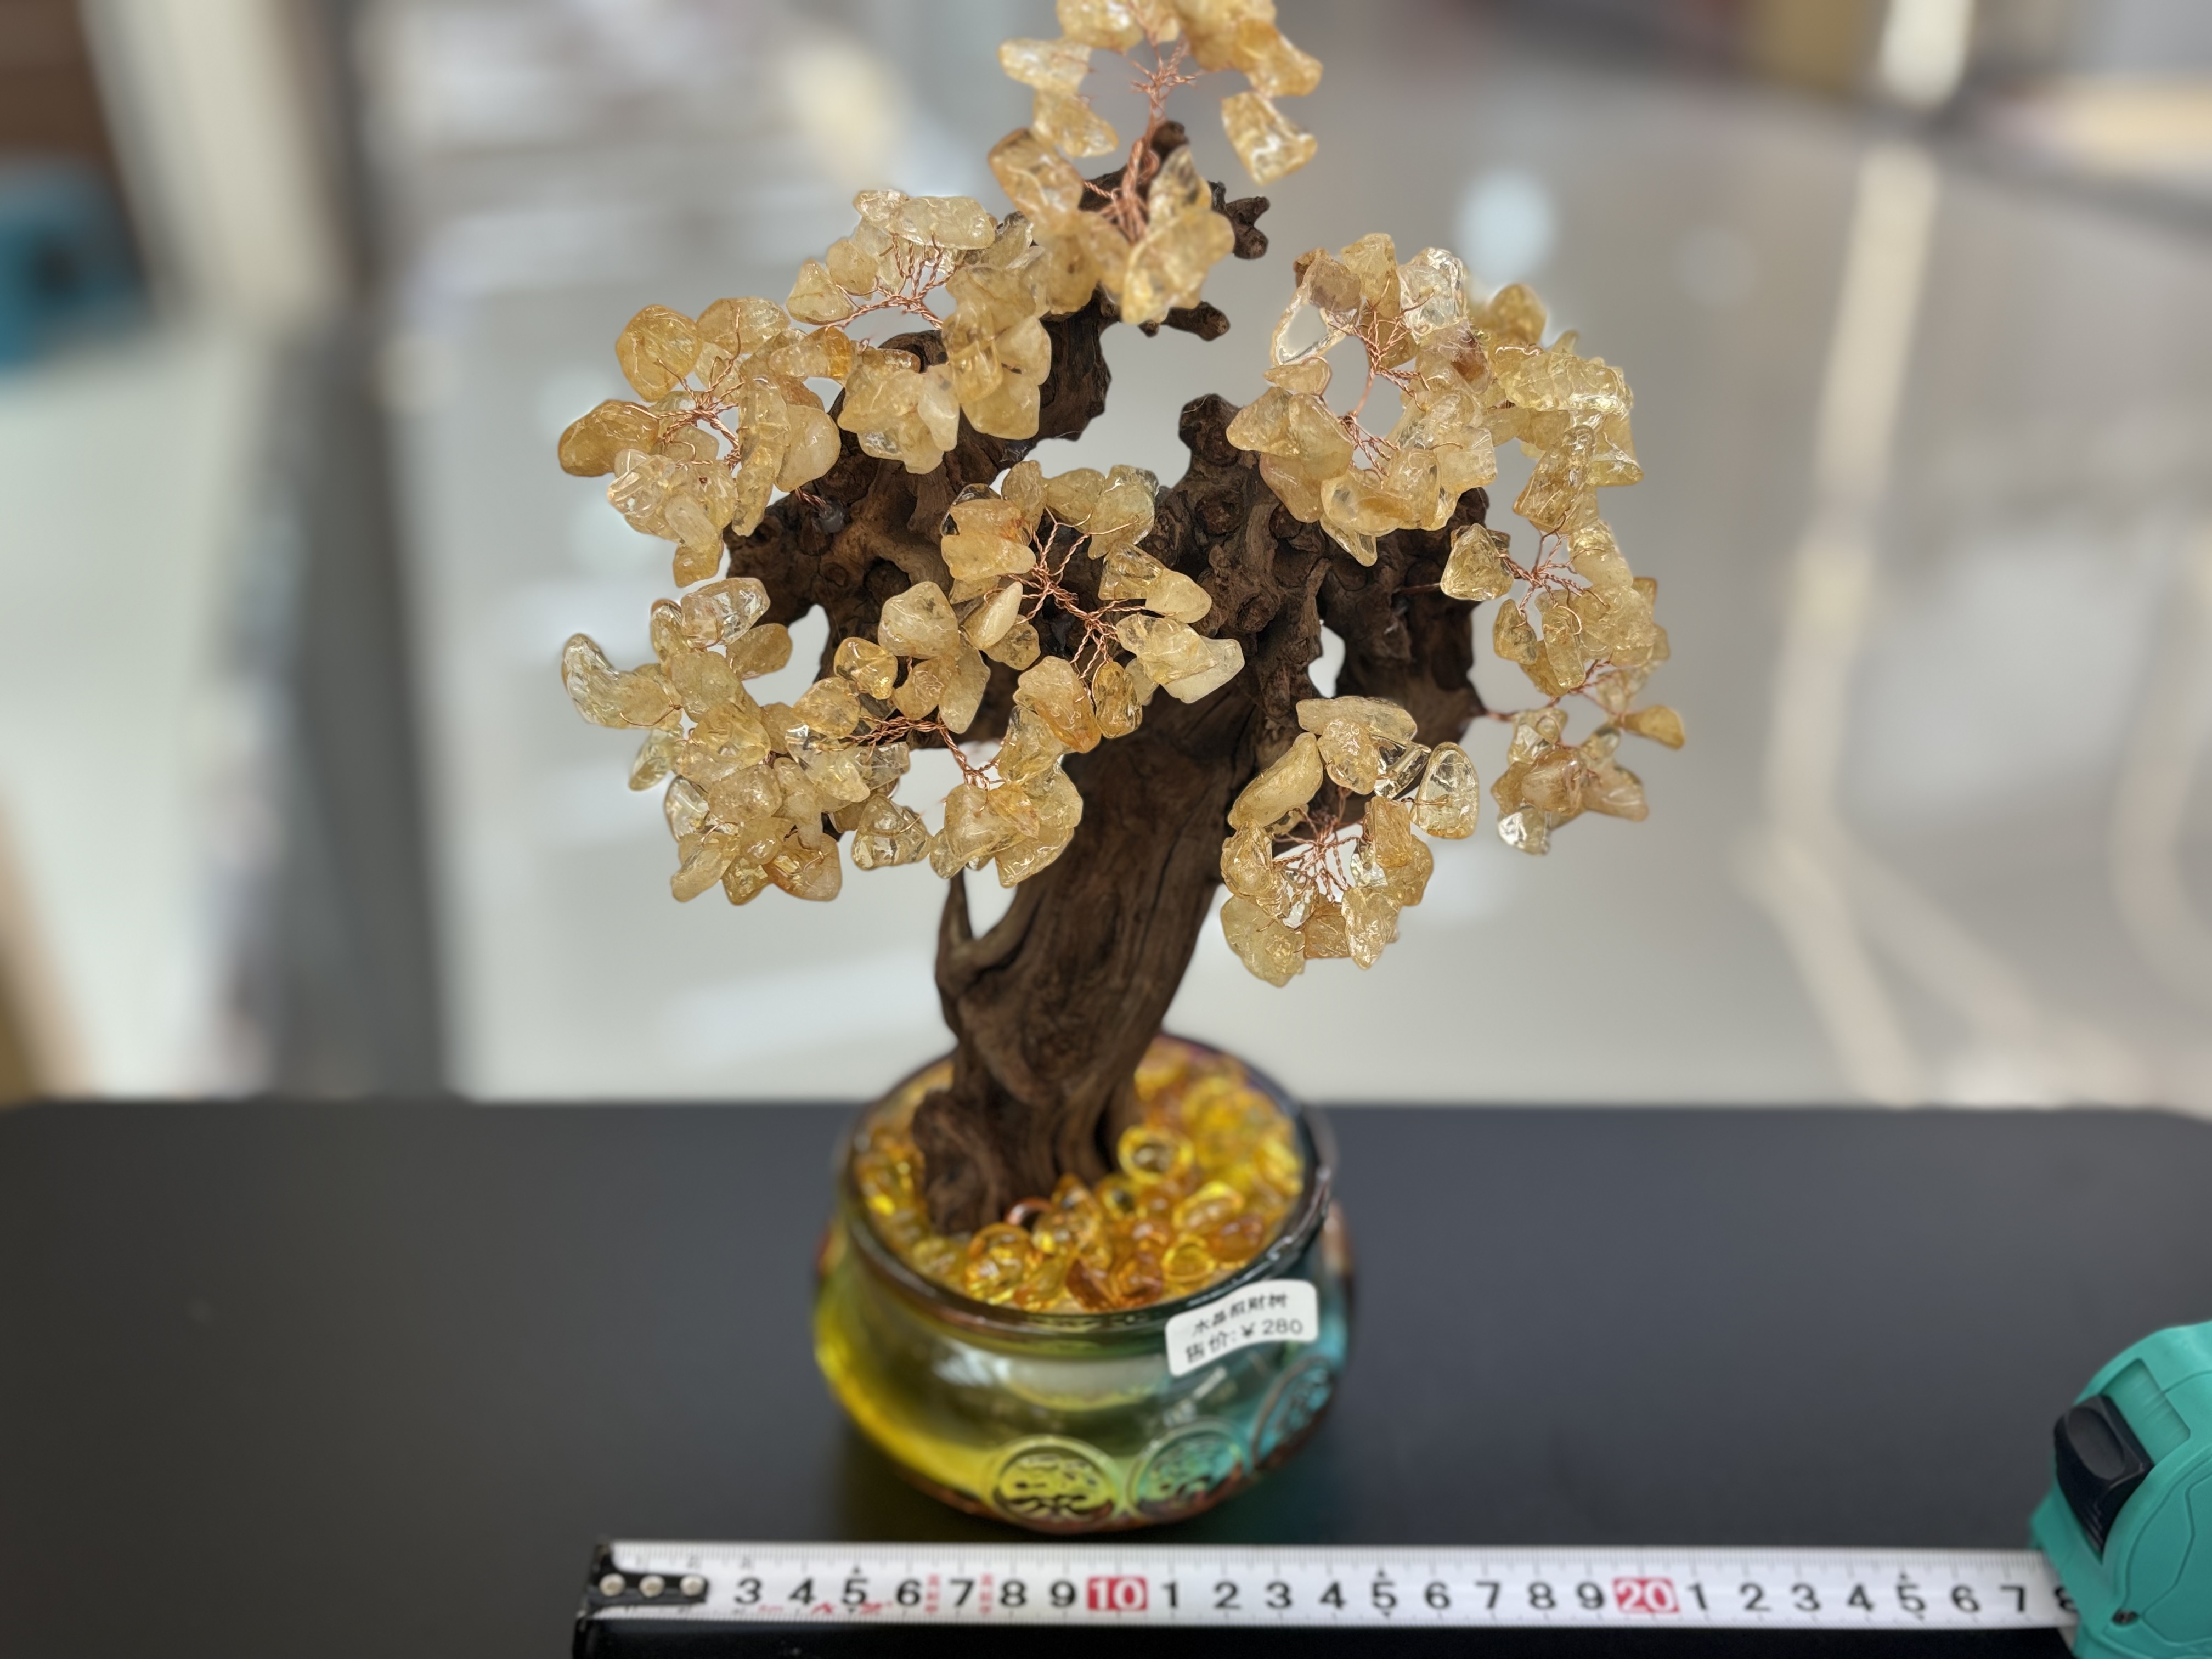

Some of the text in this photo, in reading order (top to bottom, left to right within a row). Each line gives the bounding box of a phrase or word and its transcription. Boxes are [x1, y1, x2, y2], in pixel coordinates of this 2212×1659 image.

[735, 1578, 763, 1605] 3
[788, 1578, 816, 1606] 4
[842, 1578, 867, 1605] 5
[895, 1580, 922, 1607] 6
[950, 1579, 975, 1607] 7
[1000, 1580, 1028, 1607] 8
[1049, 1580, 1077, 1607] 9
[1091, 1580, 1143, 1608] 10
[1160, 1581, 1178, 1609] 1
[1214, 1581, 1242, 1609] 2
[1265, 1582, 1293, 1609] 3
[1319, 1581, 1345, 1610] 4
[1372, 1581, 1398, 1610] 5
[1424, 1582, 1451, 1610] 6
[1476, 1582, 1500, 1610] 7
[1527, 1582, 1556, 1610] 8
[1576, 1582, 1605, 1610] 9
[1618, 1581, 1675, 1612] 20
[1687, 1582, 1707, 1611] 1
[1739, 1582, 1771, 1612] 2
[1791, 1583, 1820, 1612] 3
[1846, 1583, 1874, 1612] 4
[1895, 1584, 1926, 1612] 5
[1949, 1585, 1981, 1613] 6
[2000, 1584, 2027, 1613] 7
